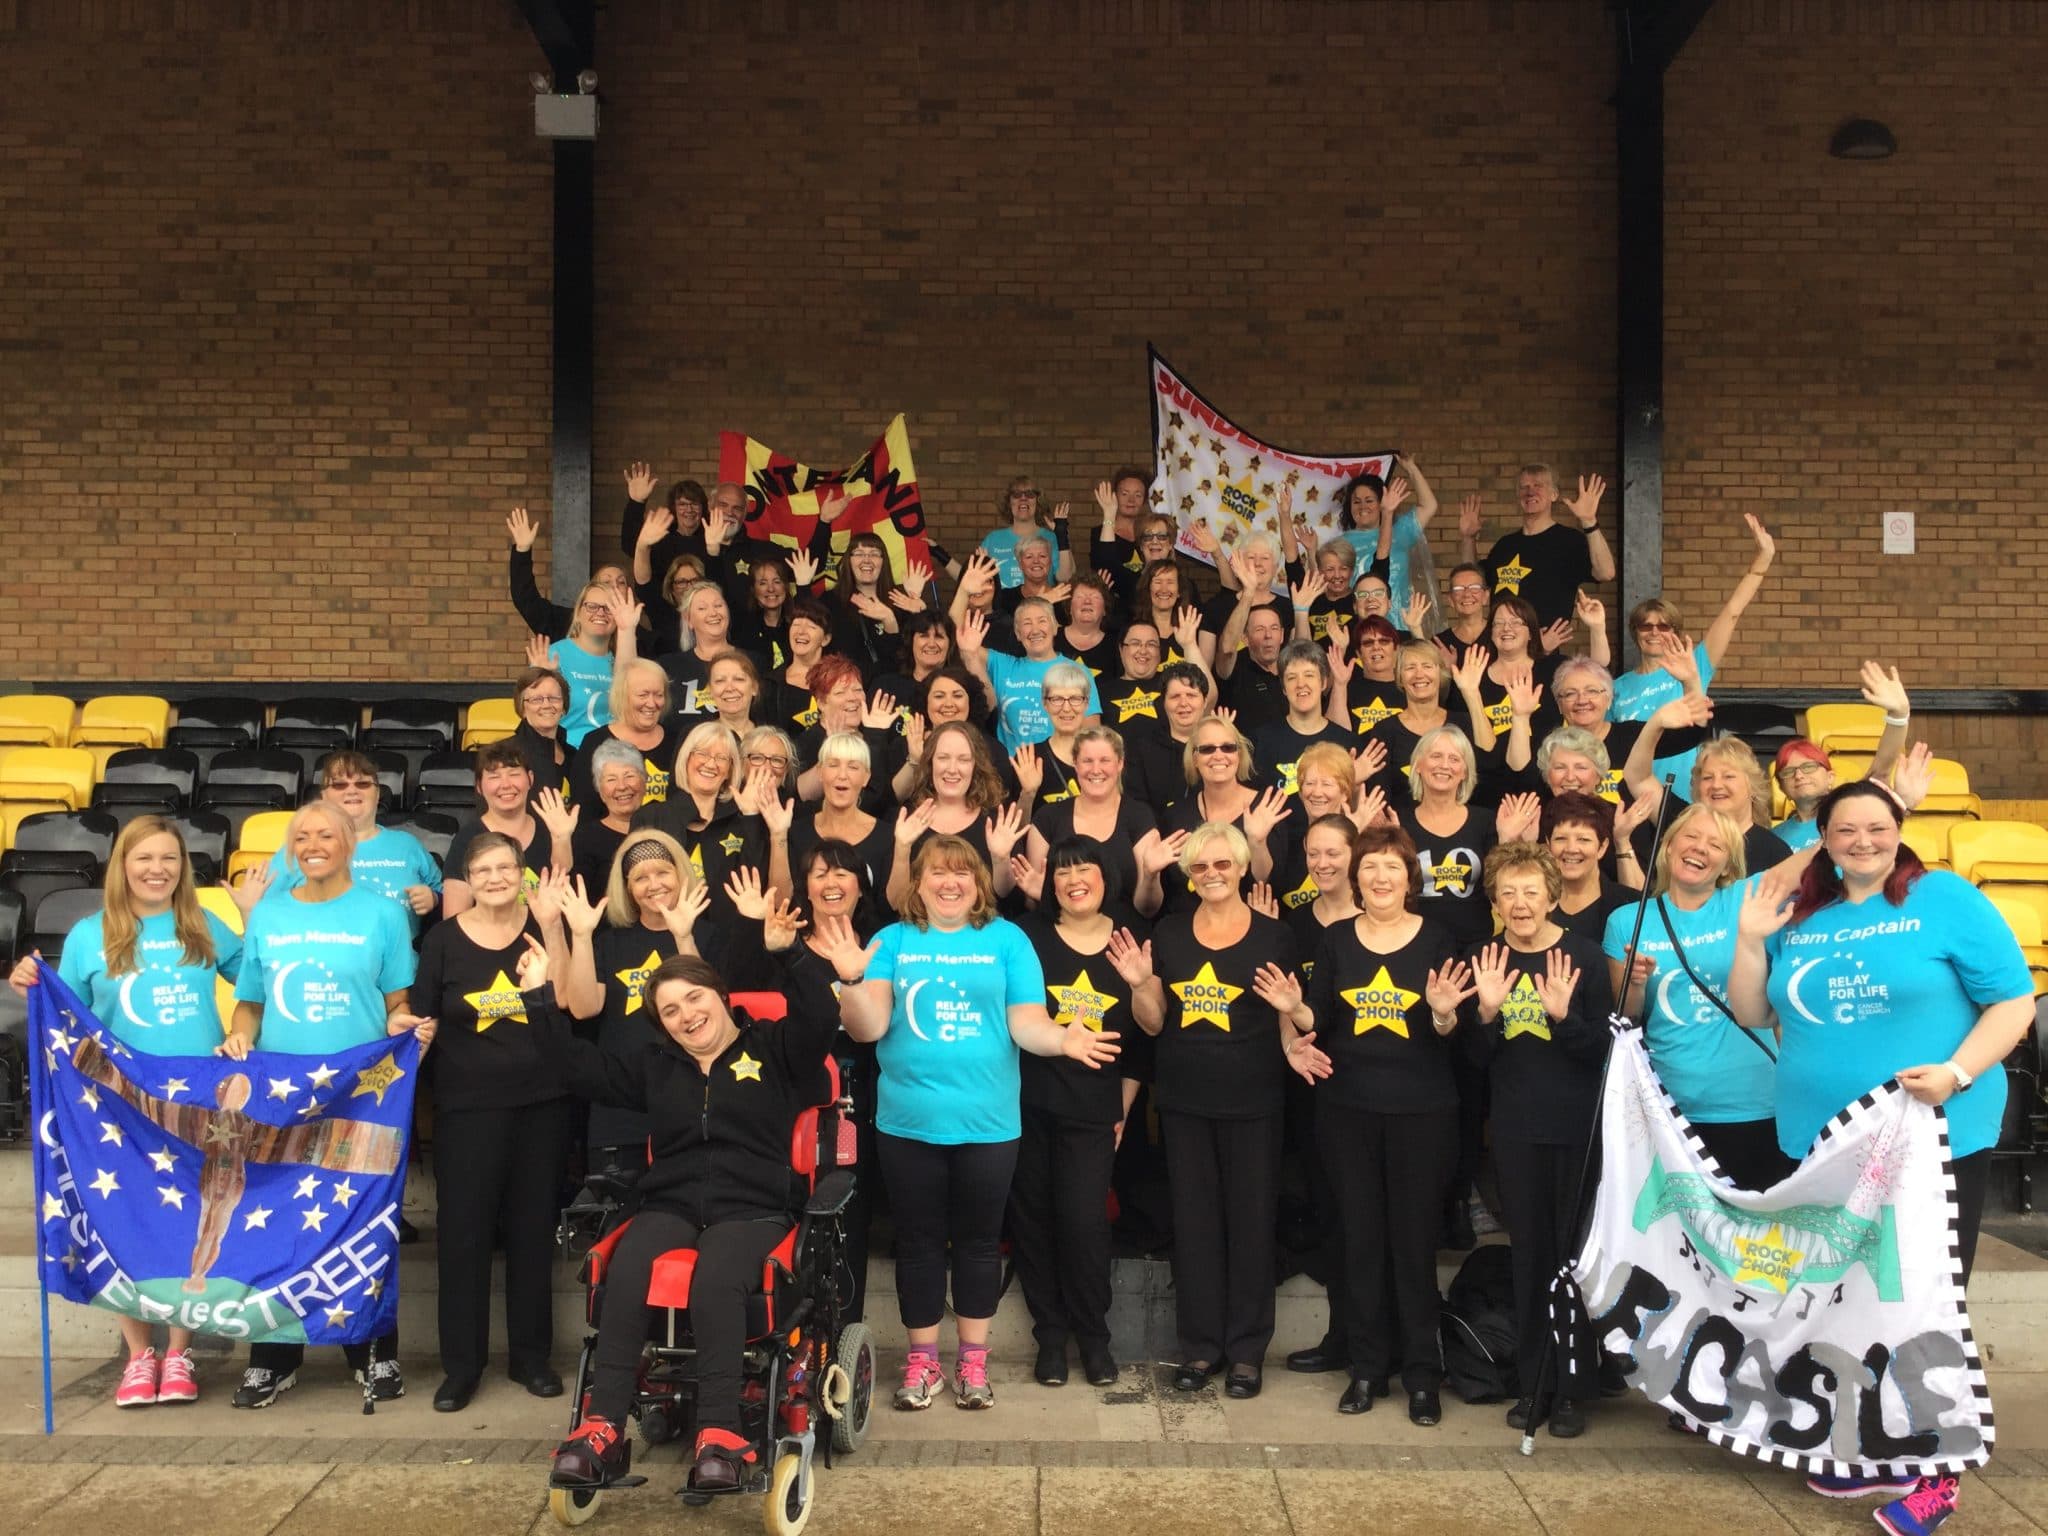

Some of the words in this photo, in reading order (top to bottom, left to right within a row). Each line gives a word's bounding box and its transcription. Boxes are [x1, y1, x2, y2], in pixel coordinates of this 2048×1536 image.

[1222, 484, 1260, 509] ROCK
[1220, 495, 1257, 524] CHOIR
[803, 711, 821, 724] RO
[1360, 708, 1393, 717] ROCK
[1491, 705, 1510, 716] RO
[1360, 715, 1387, 724] CHO
[1594, 782, 1620, 794] OIR
[351, 858, 406, 869] Member
[1434, 865, 1464, 875] ROCK
[1436, 873, 1465, 884] CHOIR
[1290, 887, 1319, 907] ROC
[1785, 930, 1829, 945] Team
[1833, 916, 1921, 942] Captain
[266, 933, 302, 948] Team
[304, 929, 367, 946] Member
[897, 954, 932, 966] Team
[934, 953, 996, 965] Member
[629, 968, 652, 982] RO
[1828, 973, 1870, 989] RELAY
[152, 982, 188, 997] RELAY
[303, 981, 338, 992] RELAY
[1182, 984, 1228, 1000] ROCK
[153, 995, 177, 1007] FOR
[303, 992, 326, 1002] FOR
[1061, 987, 1105, 1009] ROCK
[1355, 989, 1405, 1008] ROCK
[1828, 988, 1856, 1001] FOR
[935, 1000, 971, 1012] RELAY
[1181, 998, 1231, 1016] CHOIR
[1354, 1005, 1408, 1021] CHOIR
[935, 1011, 957, 1022] FOR
[1745, 1242, 1792, 1265] ROCK
[212, 1201, 400, 1338] STREET
[1742, 1257, 1791, 1279] CHOIR
